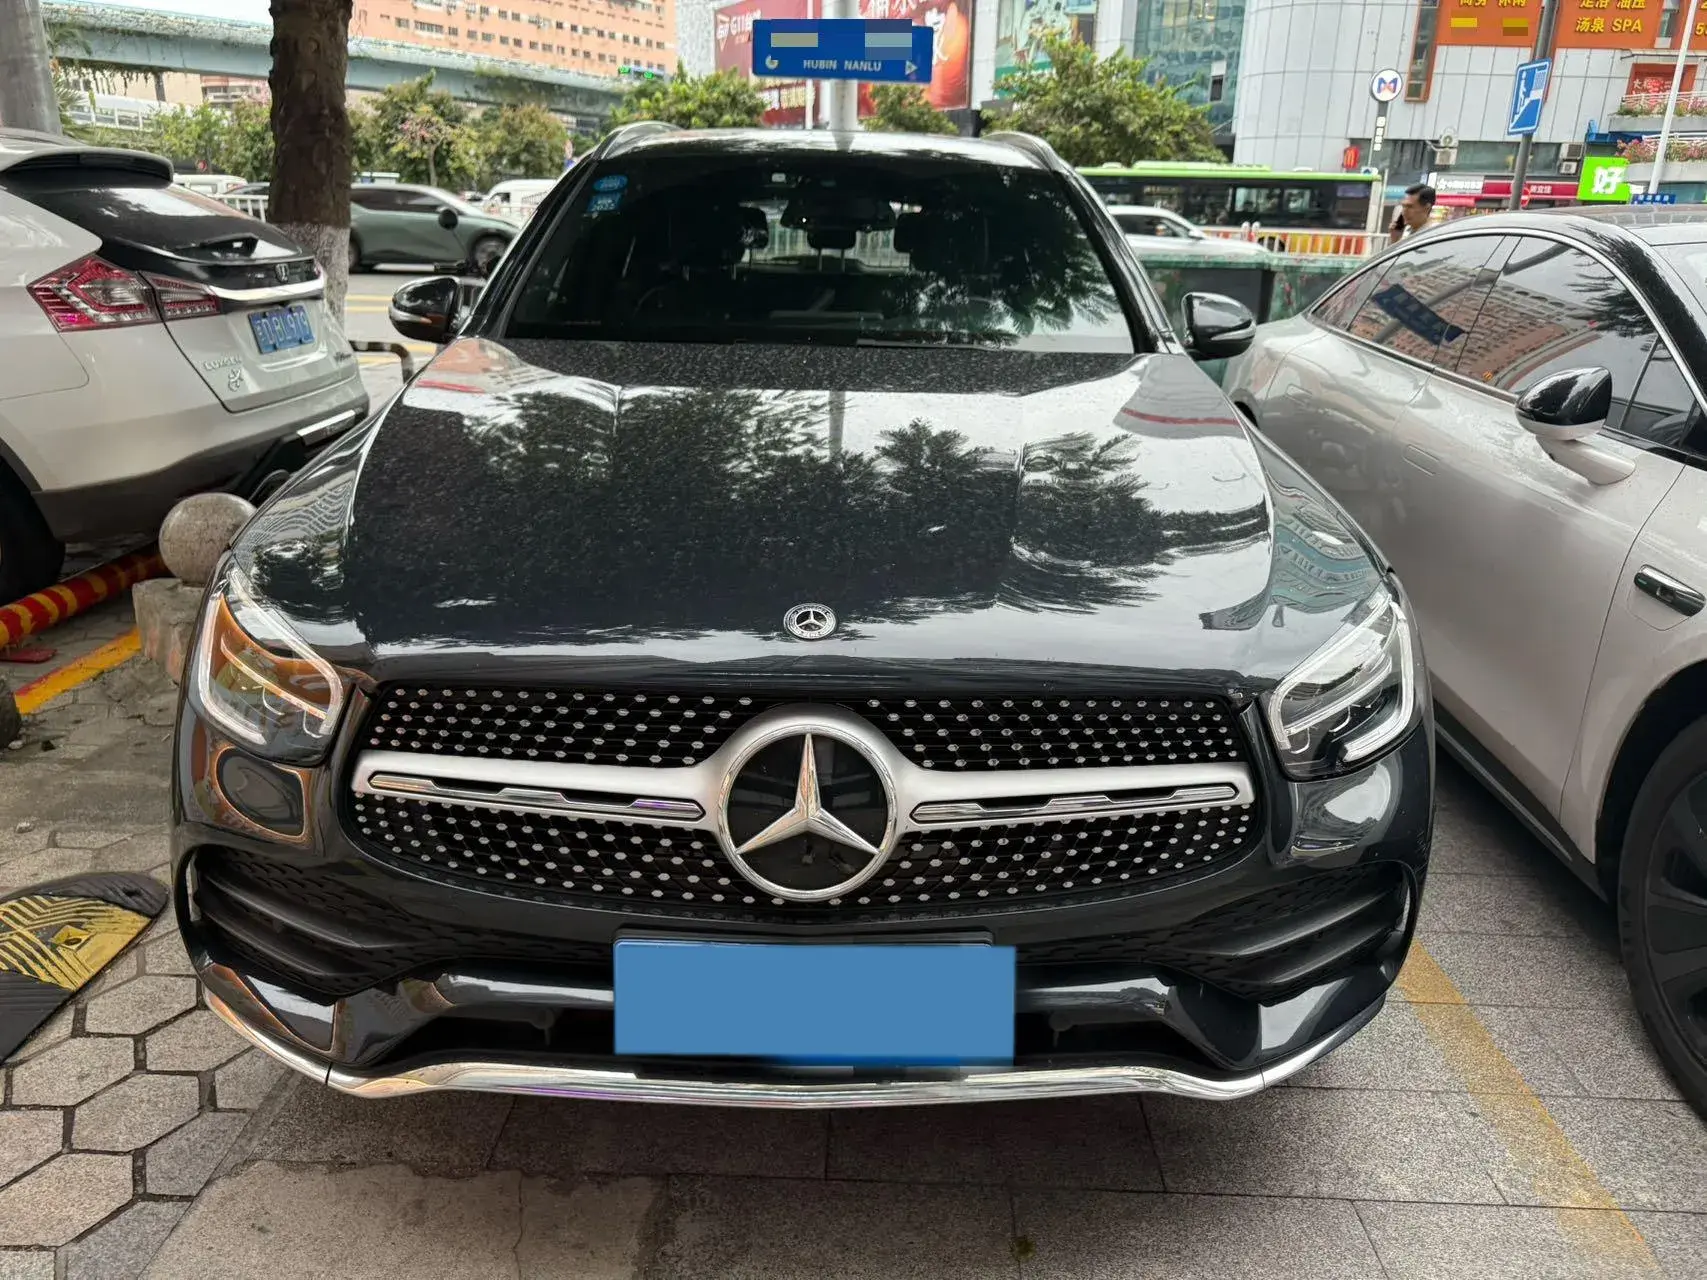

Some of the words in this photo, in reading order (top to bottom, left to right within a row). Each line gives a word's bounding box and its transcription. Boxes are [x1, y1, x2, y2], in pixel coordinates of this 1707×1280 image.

[1576, 17, 1605, 33] 汤泉
[1612, 18, 1643, 33] SPA
[803, 59, 837, 70] HUBIN
[843, 60, 882, 72] NANLU
[1593, 166, 1624, 195] 好
